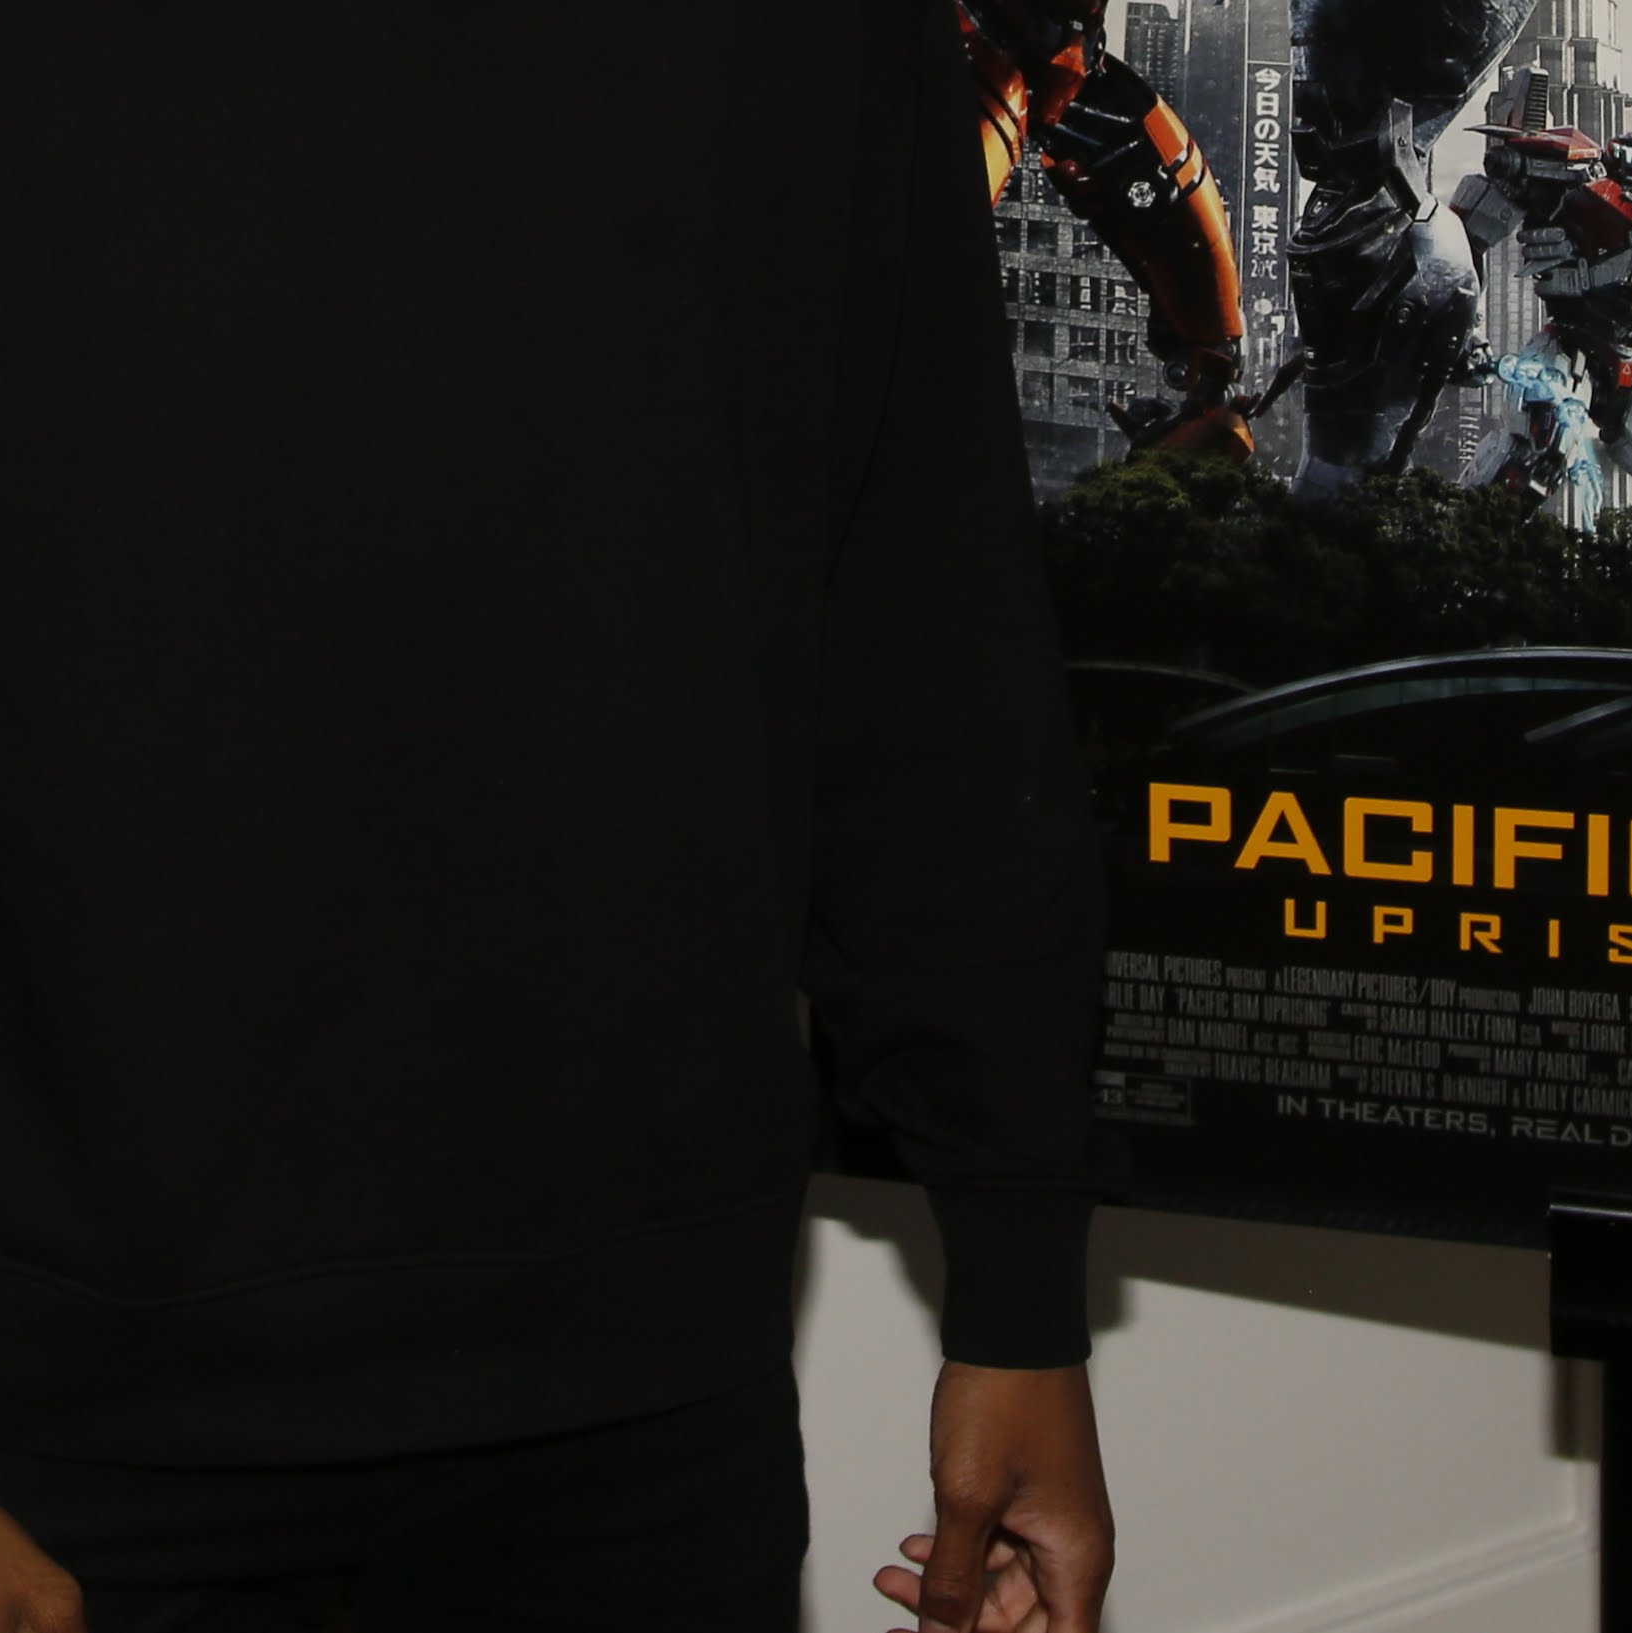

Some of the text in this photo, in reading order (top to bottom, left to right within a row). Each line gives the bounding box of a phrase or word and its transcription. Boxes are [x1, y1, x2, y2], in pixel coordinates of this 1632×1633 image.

[1253, 67, 1282, 194] 今日の天気
[1251, 204, 1280, 256] 東京
[1138, 984, 1165, 1013] DAY
[1232, 992, 1260, 1021] RIM
[1380, 1006, 1426, 1036] SARAH
[1429, 1009, 1480, 1040] HALLEY
[1484, 1014, 1517, 1043] FINN
[1583, 1023, 1626, 1053] LORNE
[1163, 955, 1223, 986] PICTURES
[1282, 966, 1355, 998] LEGENDARY
[1528, 987, 1565, 1016] JOHN
[1568, 990, 1621, 1021] BOYEGA
[1168, 1016, 1196, 1047] DAN
[1354, 1035, 1383, 1064] ERIC
[1494, 1047, 1534, 1077] MARY
[1537, 1051, 1587, 1082] PARENT
[1214, 1051, 1262, 1082] TRAVIS
[1264, 1056, 1331, 1089] BEACHAM
[1370, 1067, 1422, 1097] STEVEN
[1524, 1081, 1567, 1113] EMILY
[1277, 1094, 1309, 1117] IN
[1317, 1097, 1497, 1139] THEATERS,
